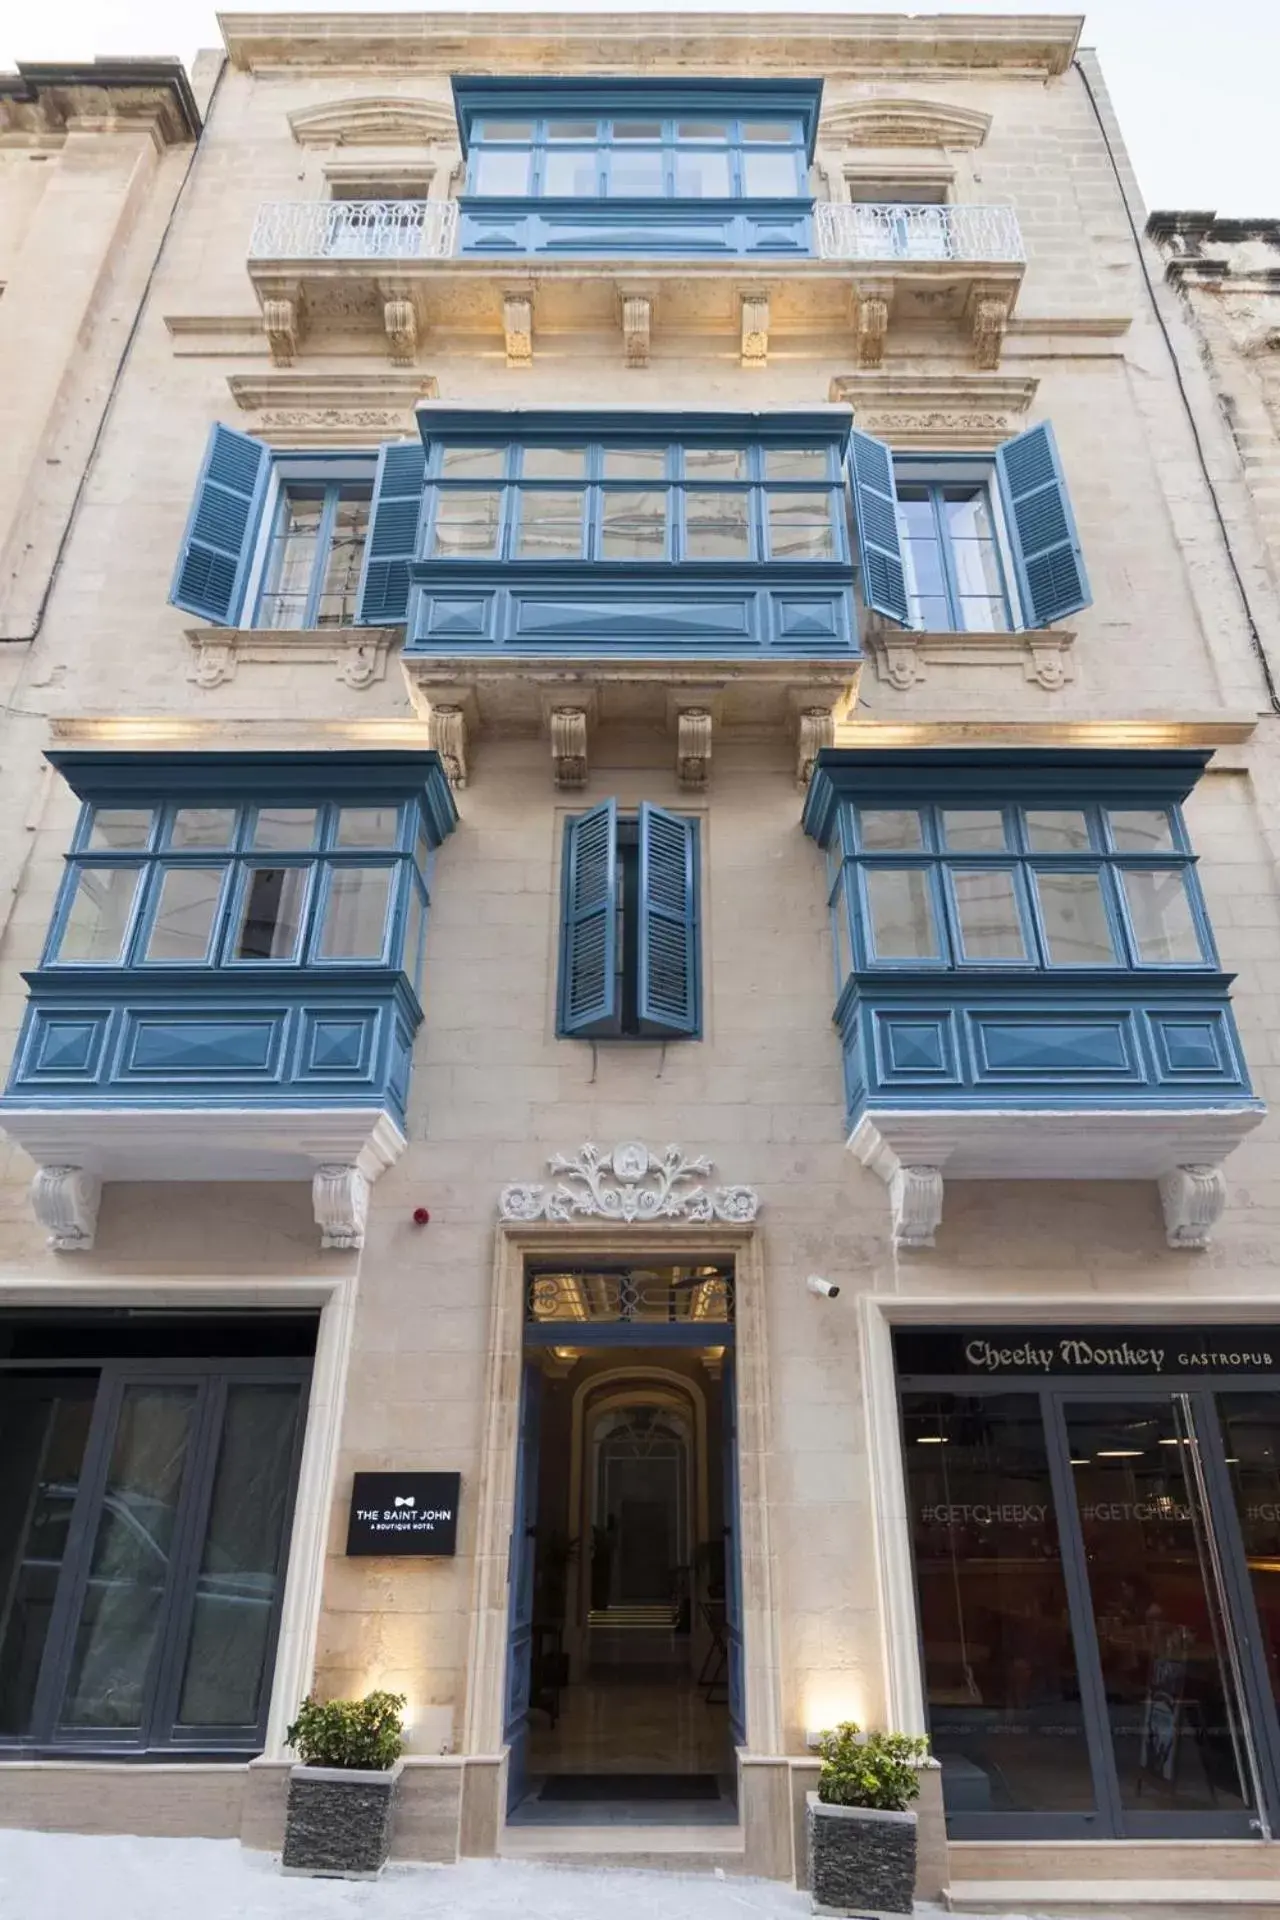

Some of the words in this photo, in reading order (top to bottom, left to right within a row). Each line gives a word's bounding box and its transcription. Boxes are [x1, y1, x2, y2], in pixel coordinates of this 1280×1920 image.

[965, 1340, 1054, 1372] Cheeky
[1060, 1340, 1165, 1372] Monkey
[1178, 1352, 1273, 1366] GASTROPUB
[356, 1511, 379, 1520] THE
[383, 1511, 418, 1520] SAINT
[420, 1511, 451, 1520] JOHN
[921, 1504, 1048, 1522] #GETCHEEKY
[376, 1523, 411, 1531] BOUTIQUE
